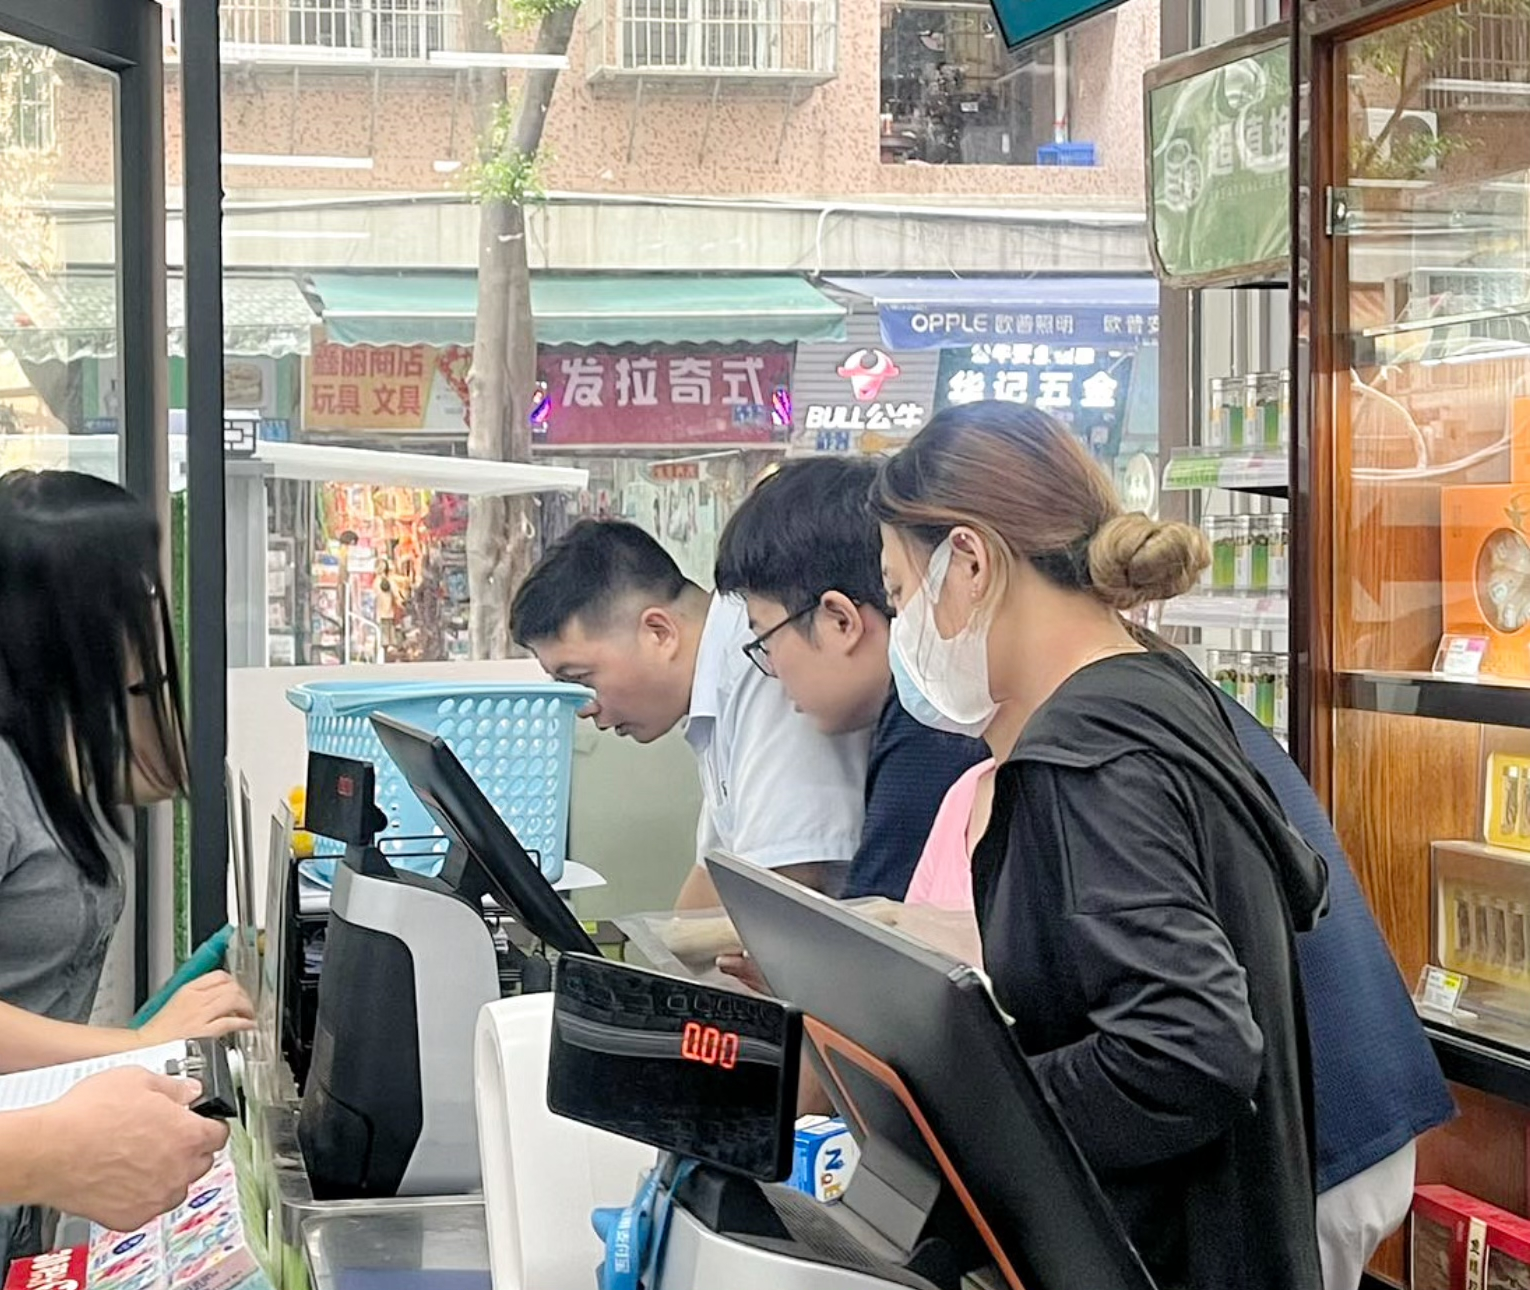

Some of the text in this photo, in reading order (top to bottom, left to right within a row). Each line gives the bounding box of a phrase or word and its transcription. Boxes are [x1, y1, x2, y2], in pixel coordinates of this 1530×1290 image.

[910, 313, 988, 333] OPPLE
[995, 314, 1075, 335] 欧普照明
[560, 357, 763, 407] 发拉奇式
[947, 369, 1118, 408] 华记五金
[312, 384, 423, 415] 玩具 文具
[805, 402, 925, 430] BULL公牛
